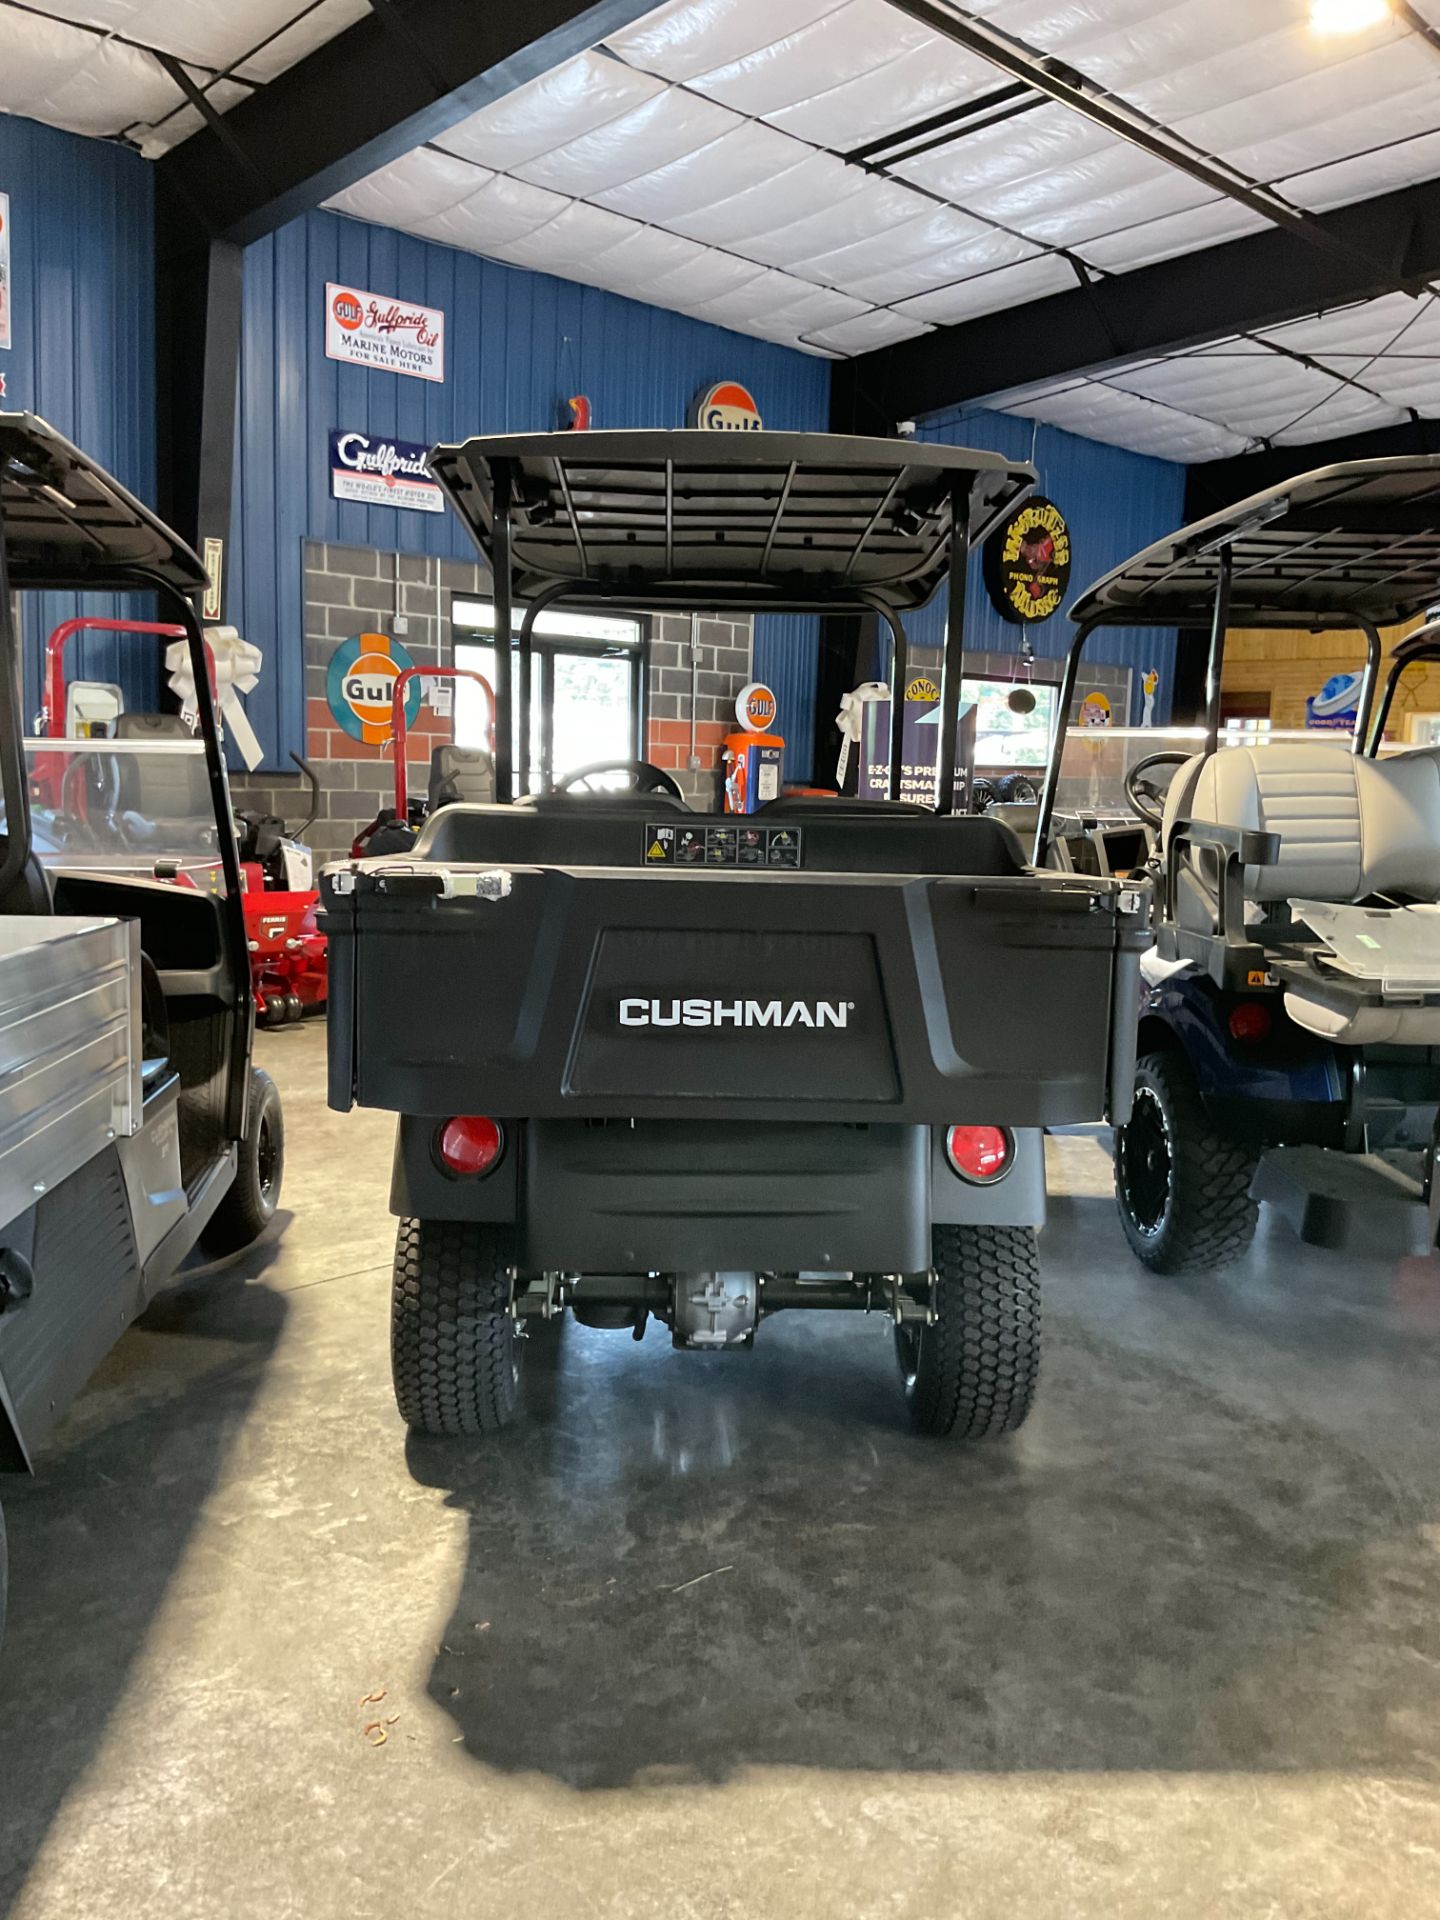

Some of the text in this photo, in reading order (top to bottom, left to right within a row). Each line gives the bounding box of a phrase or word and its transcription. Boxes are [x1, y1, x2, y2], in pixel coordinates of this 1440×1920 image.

[335, 300, 361, 320] GULF
[364, 300, 439, 347] Gulfpride Oil
[341, 334, 433, 365] MARINE MOTORS
[350, 349, 422, 372] FOR SALE HERE
[346, 678, 407, 701] Gul
[906, 680, 940, 700] CONOC
[749, 698, 774, 716] GULF
[619, 998, 848, 1028] CUSHMAN
